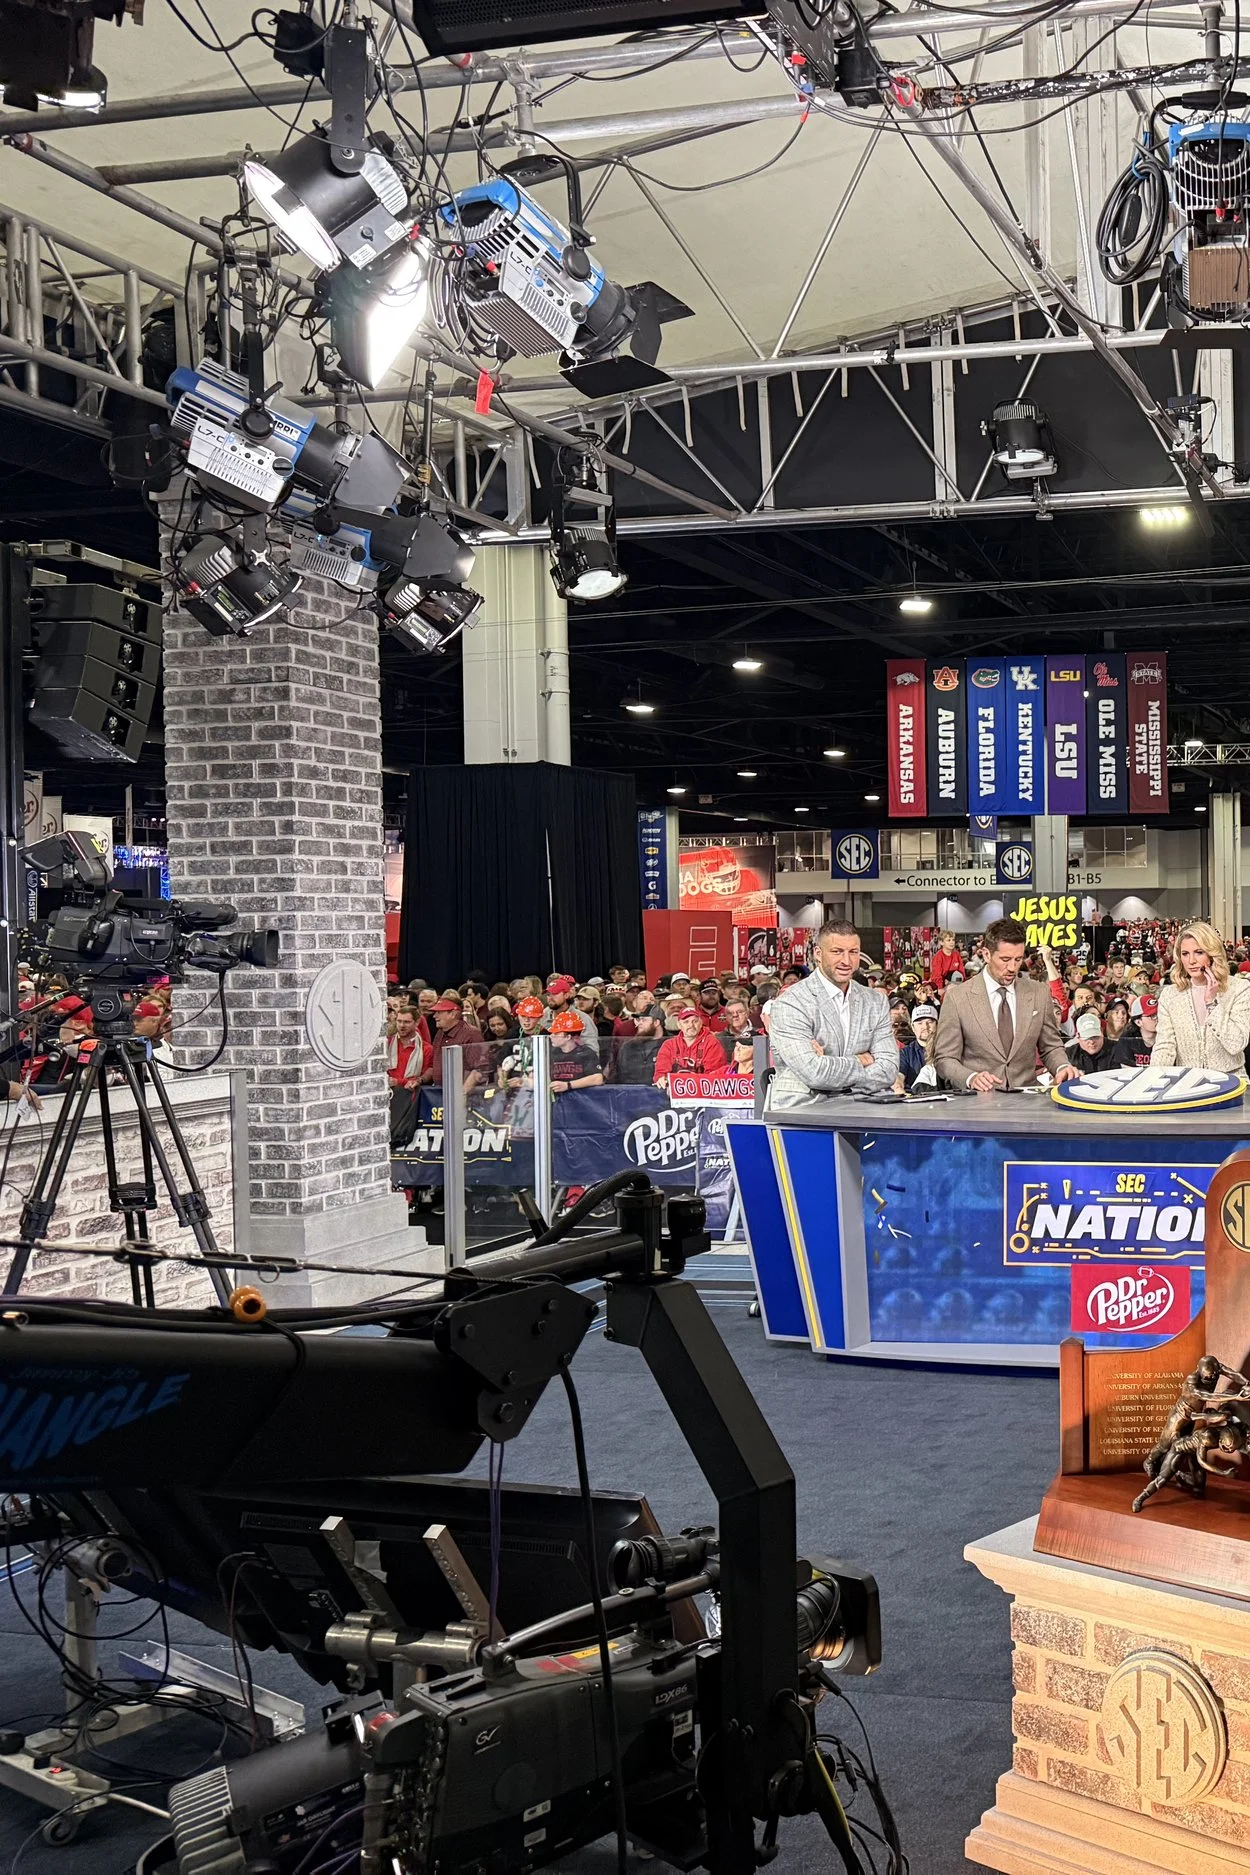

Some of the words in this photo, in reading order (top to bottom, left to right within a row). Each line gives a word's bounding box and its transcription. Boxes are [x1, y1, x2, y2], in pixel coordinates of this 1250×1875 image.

[510, 252, 532, 276] L7-C
[198, 425, 225, 443] L7-C
[1050, 670, 1080, 682] LSU
[1096, 674, 1118, 687] Miss
[1098, 698, 1115, 739] OLE
[899, 703, 914, 804] ARKANSAS
[938, 708, 956, 800] AUBURN
[978, 706, 996, 797] FLORIDA
[1018, 702, 1032, 802] KENTUCKY
[1054, 724, 1078, 780] LSU
[1134, 723, 1148, 774] STATE
[1148, 700, 1162, 796] MISSISSIPPI
[1099, 745, 1116, 799] MISS
[839, 836, 872, 872] SEC
[1002, 848, 1032, 878] SEC
[907, 875, 970, 887] Connector
[973, 876, 986, 886] to
[28, 888, 36, 921] Allstat
[1010, 896, 1077, 921] JESUS
[1025, 923, 1078, 948] AVES
[553, 1064, 584, 1074] AWGS
[1070, 1067, 1230, 1102] SEC
[674, 1078, 698, 1096] GO
[431, 1107, 443, 1121] SE
[658, 1109, 692, 1140] Dr
[396, 1128, 507, 1152] ATON
[625, 1116, 700, 1166] Peppe
[708, 1158, 731, 1166] NAT
[1115, 1173, 1146, 1194] SEC
[1090, 1282, 1168, 1325] Pepper
[1117, 1276, 1148, 1302] Dr
[0, 1373, 191, 1470] IANGLE
[655, 1684, 688, 1704] LDX86
[1109, 1666, 1207, 1799] SEC
